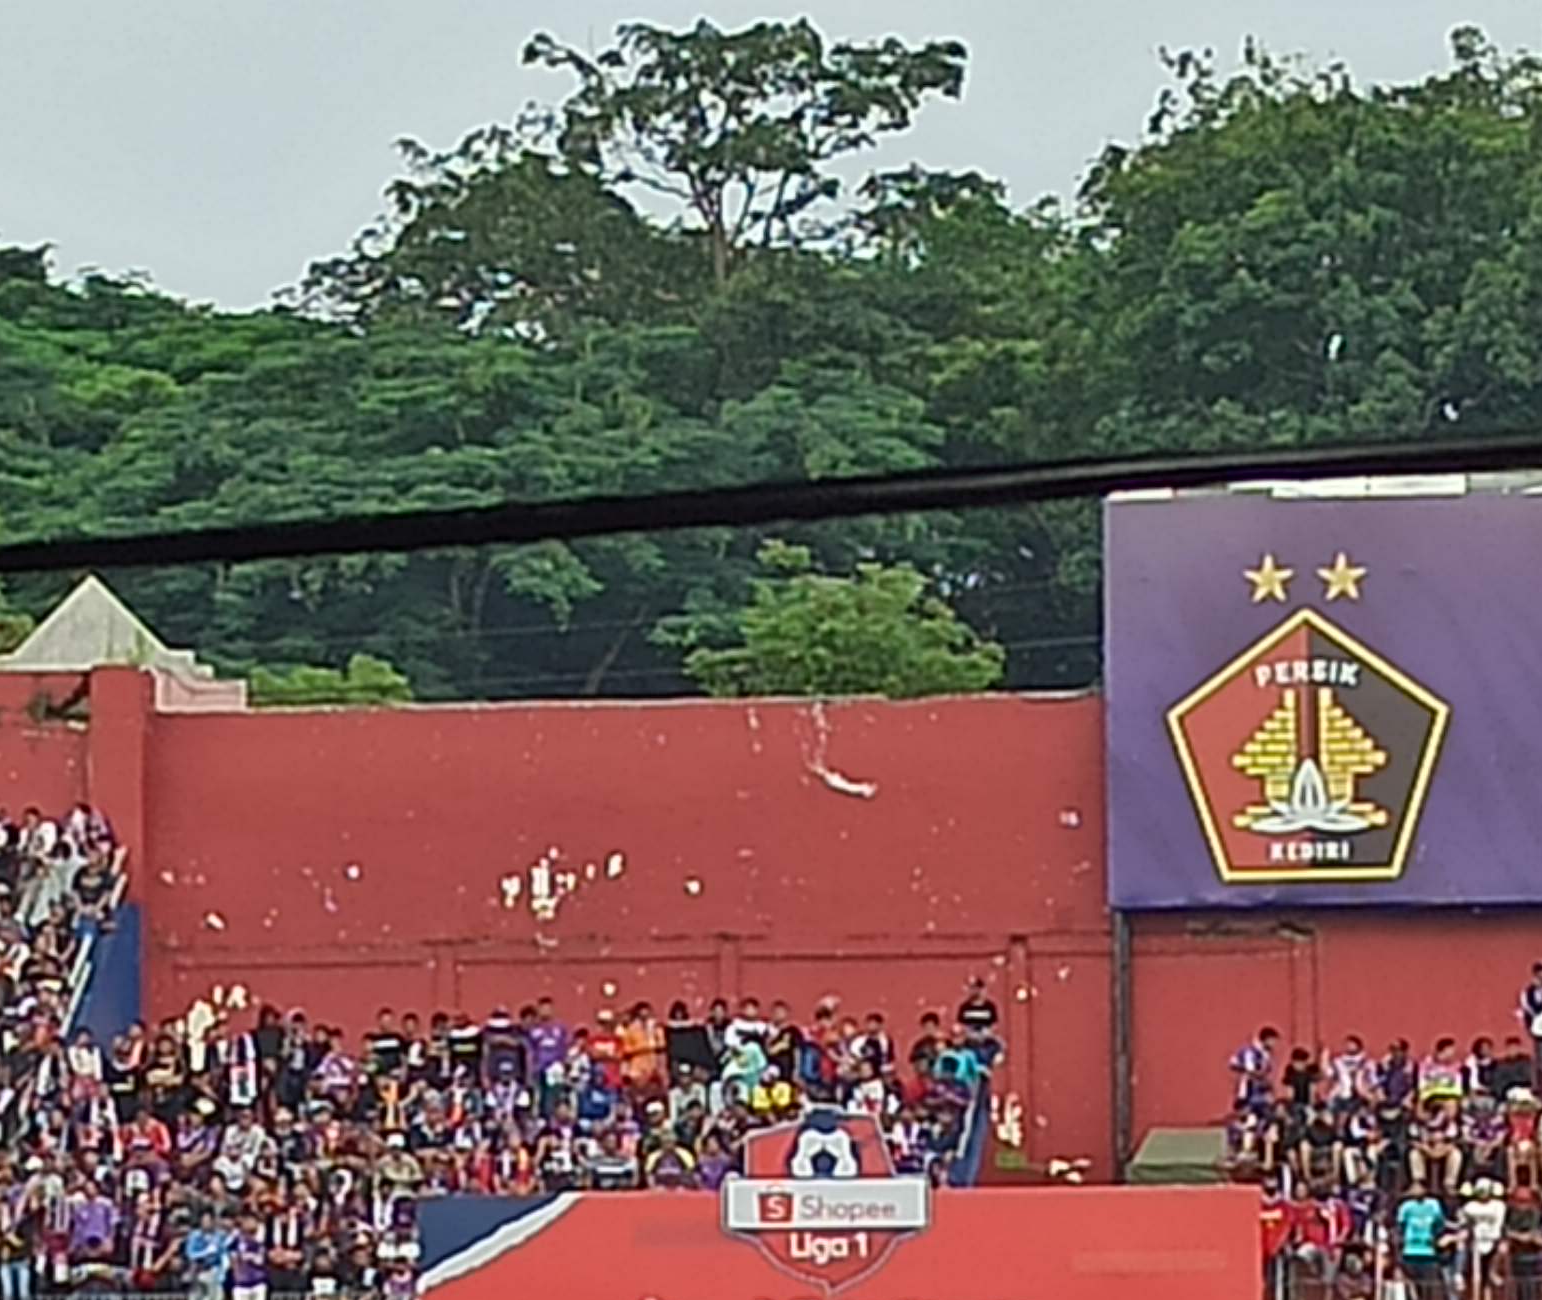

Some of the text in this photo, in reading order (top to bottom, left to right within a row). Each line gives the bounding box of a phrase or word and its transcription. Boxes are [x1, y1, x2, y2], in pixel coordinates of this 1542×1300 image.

[1255, 658, 1360, 687] PERSIK
[1269, 841, 1351, 861] KEDIRI
[799, 1194, 897, 1222] Shopee
[789, 1231, 868, 1264] Liga 1
